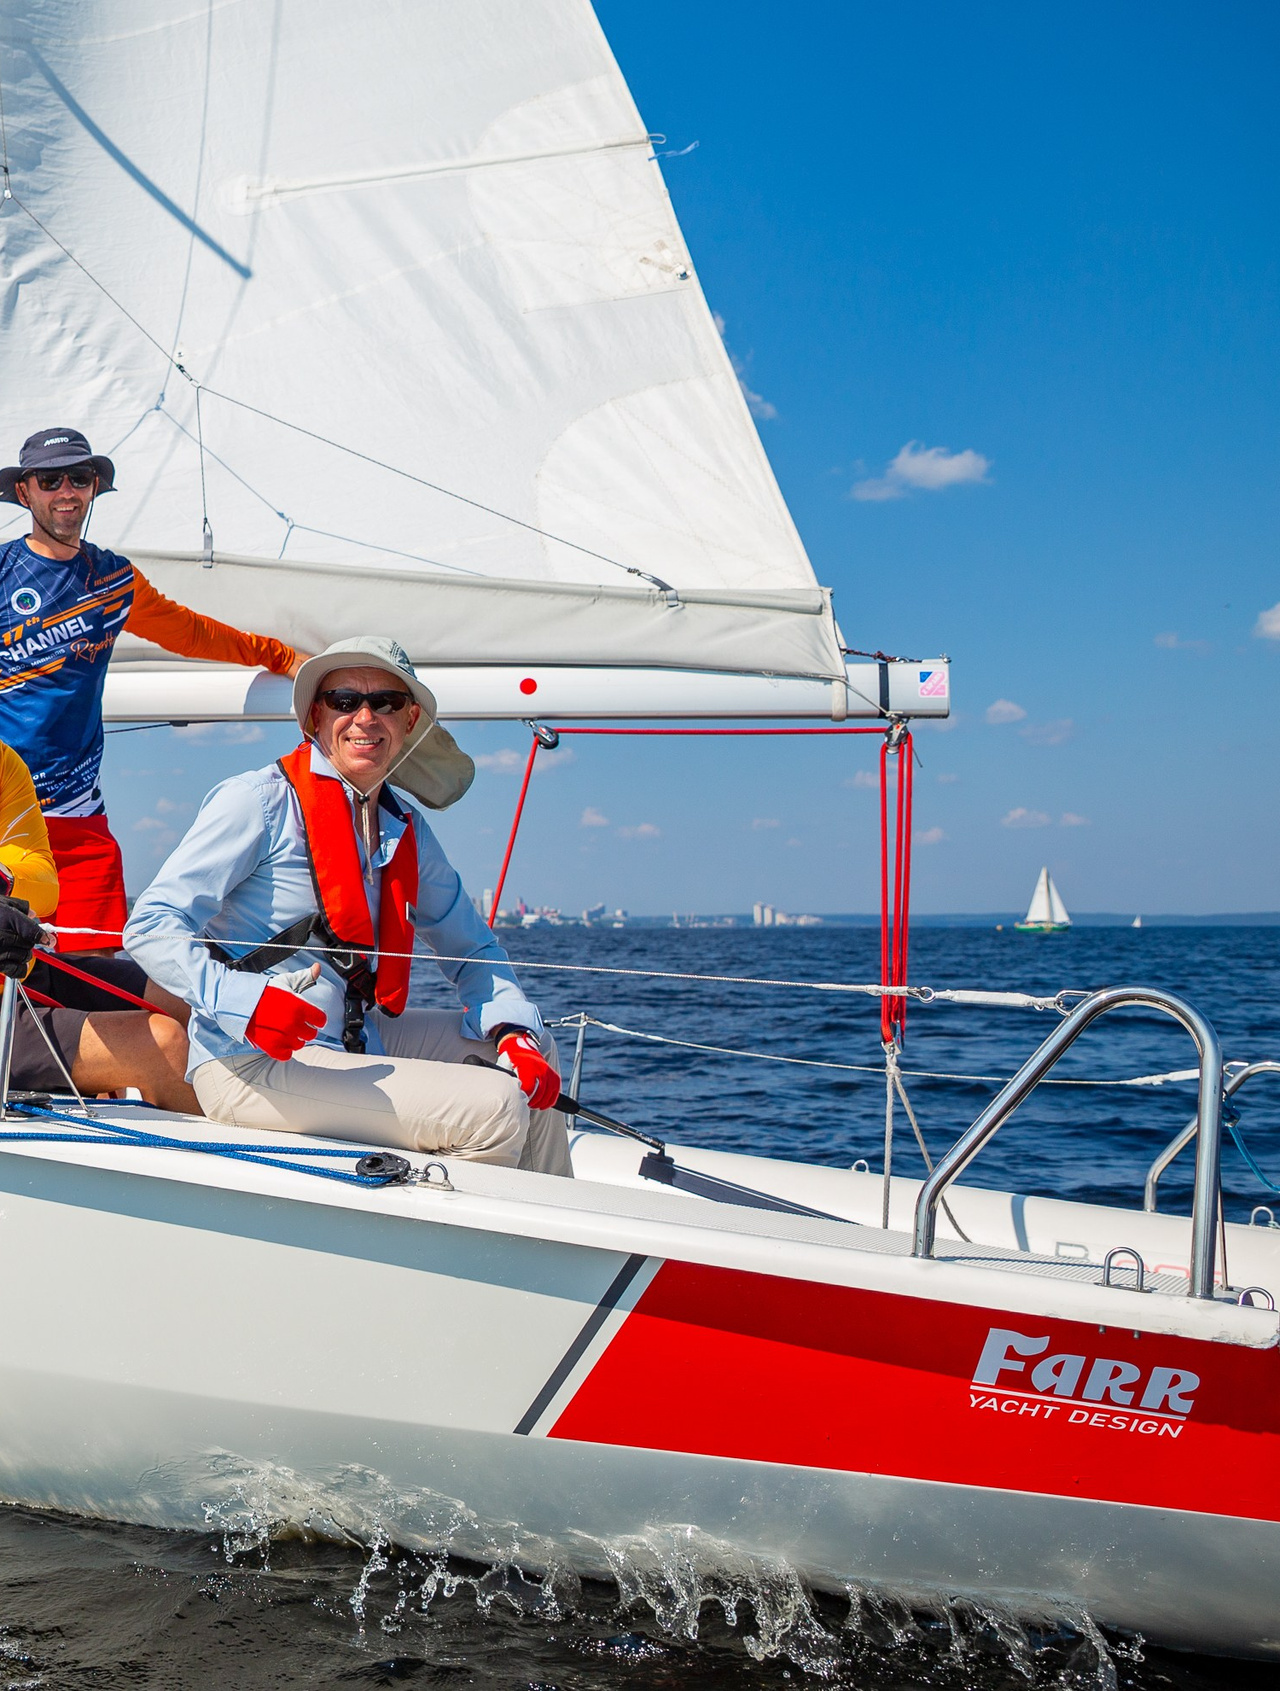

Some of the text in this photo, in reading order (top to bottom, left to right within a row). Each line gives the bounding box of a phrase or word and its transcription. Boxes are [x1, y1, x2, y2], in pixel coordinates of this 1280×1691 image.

[43, 436, 69, 447] MUSTO
[968, 1394, 1184, 1438] YACHT DESIGN
